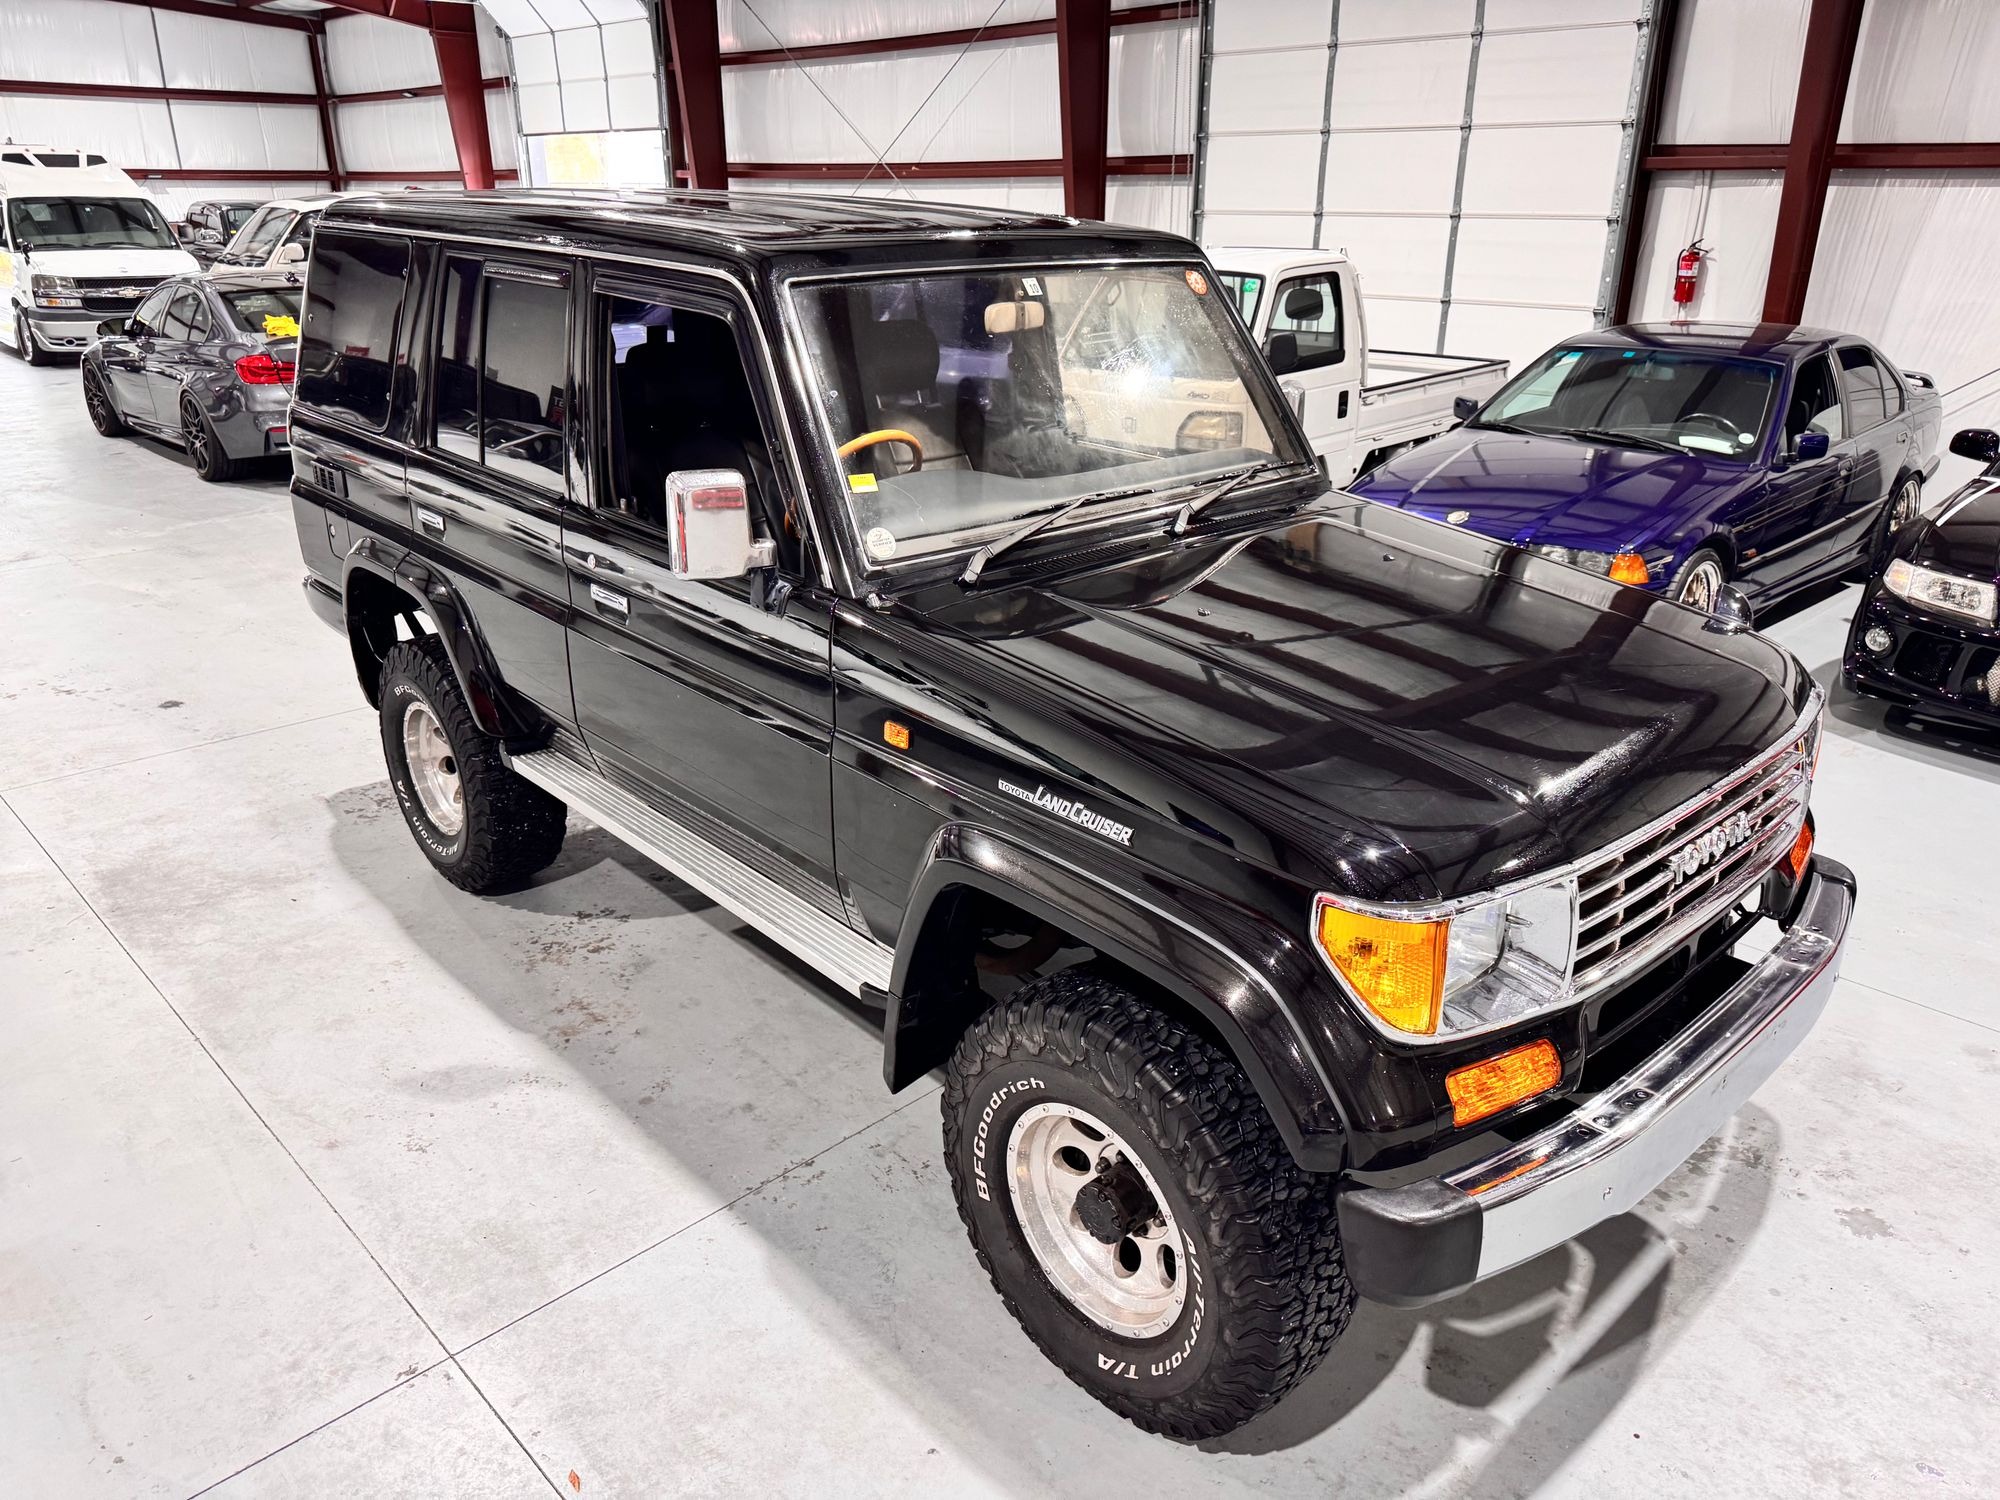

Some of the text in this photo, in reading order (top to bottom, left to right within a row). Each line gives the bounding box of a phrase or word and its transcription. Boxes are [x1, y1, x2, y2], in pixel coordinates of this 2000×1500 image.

[397, 780, 411, 809] T/A
[999, 780, 1033, 802] TOYOTA
[1669, 811, 1752, 885] TOYOTA
[972, 1076, 1046, 1201] BFGoodrich
[1097, 1352, 1139, 1380] T/A
